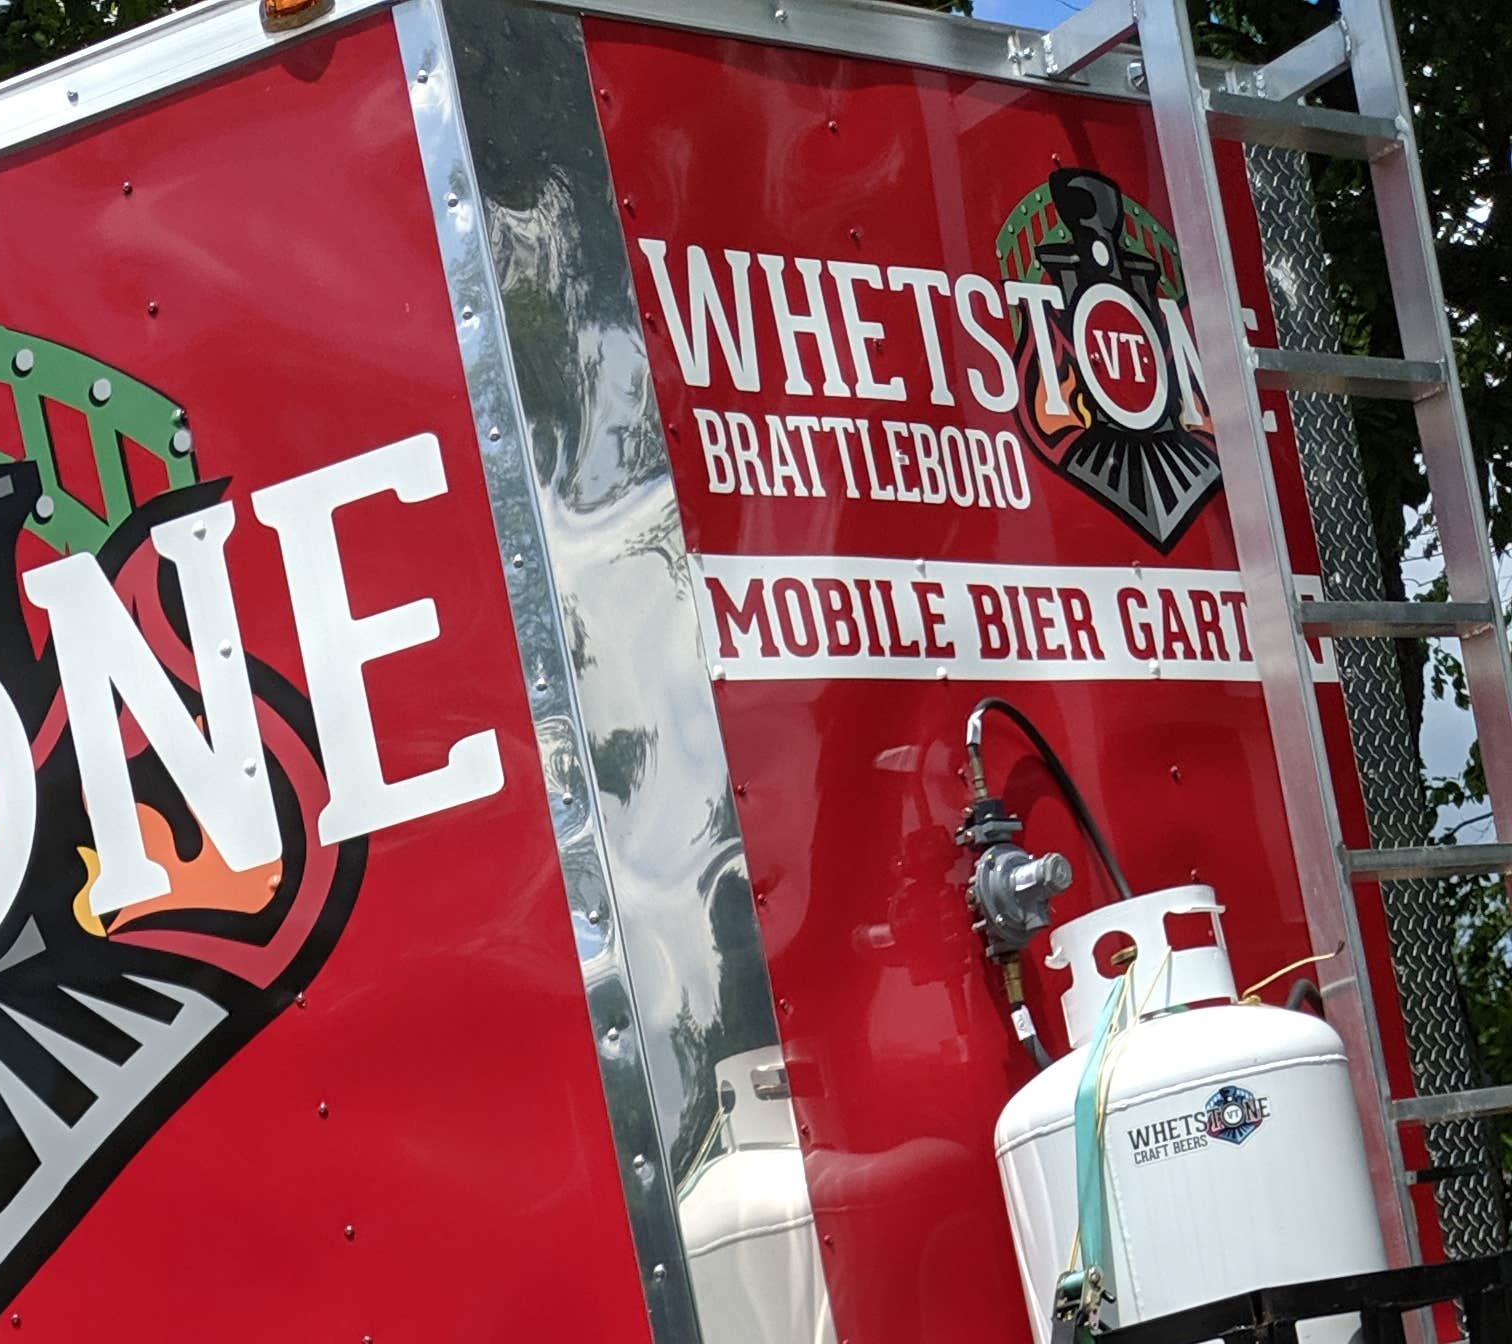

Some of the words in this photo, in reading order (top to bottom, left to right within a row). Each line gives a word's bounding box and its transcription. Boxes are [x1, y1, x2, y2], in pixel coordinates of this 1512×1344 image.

[638, 238, 1278, 431] WHETSTON
[692, 408, 1032, 510] BRATTLEBORO
[704, 577, 956, 659] MOBILE
[966, 583, 1105, 661] BIER
[1116, 587, 1324, 664] GART
[1127, 1096, 1271, 1151] WHETSTONE
[1134, 1143, 1170, 1165] CRAFT
[1173, 1134, 1209, 1155] BEERS
